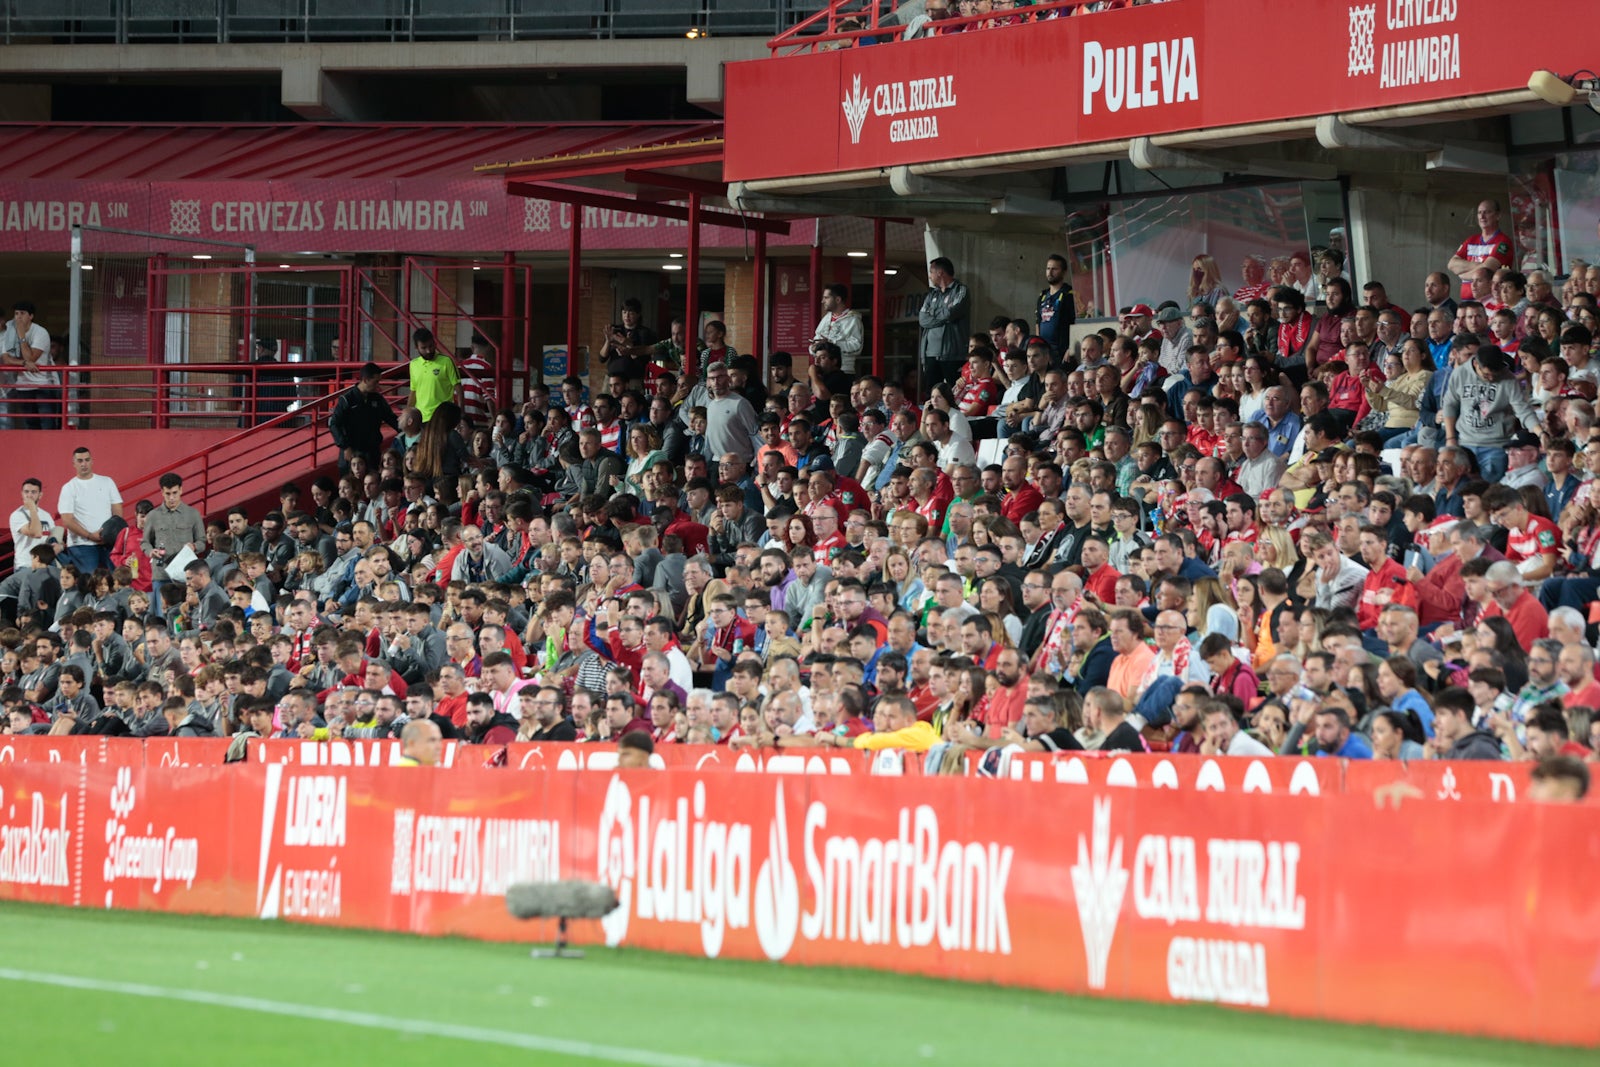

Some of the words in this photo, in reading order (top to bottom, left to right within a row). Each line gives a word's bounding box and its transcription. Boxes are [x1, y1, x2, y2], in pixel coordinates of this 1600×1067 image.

[874, 81, 906, 117] CAJA
[909, 75, 957, 112] RURAL
[1083, 37, 1199, 115] PULEVA
[1380, 33, 1461, 89] ALHAMBRA
[889, 116, 939, 143] GRANADA
[0, 201, 101, 231] AMBRA
[107, 202, 129, 218] SIN
[211, 200, 325, 232] CERVEZAS
[333, 200, 465, 231] ALHAMBRA
[469, 200, 488, 217] SIN
[284, 775, 347, 847] LIDERA
[414, 815, 481, 894] CERVEZAS
[481, 818, 560, 895] ALHAMBRA
[637, 780, 751, 958] LaLiga
[801, 801, 1013, 955] SmartBank
[1133, 834, 1200, 926] CAJA
[1206, 838, 1306, 929] RURAL
[1166, 936, 1270, 1007] GRANADA
